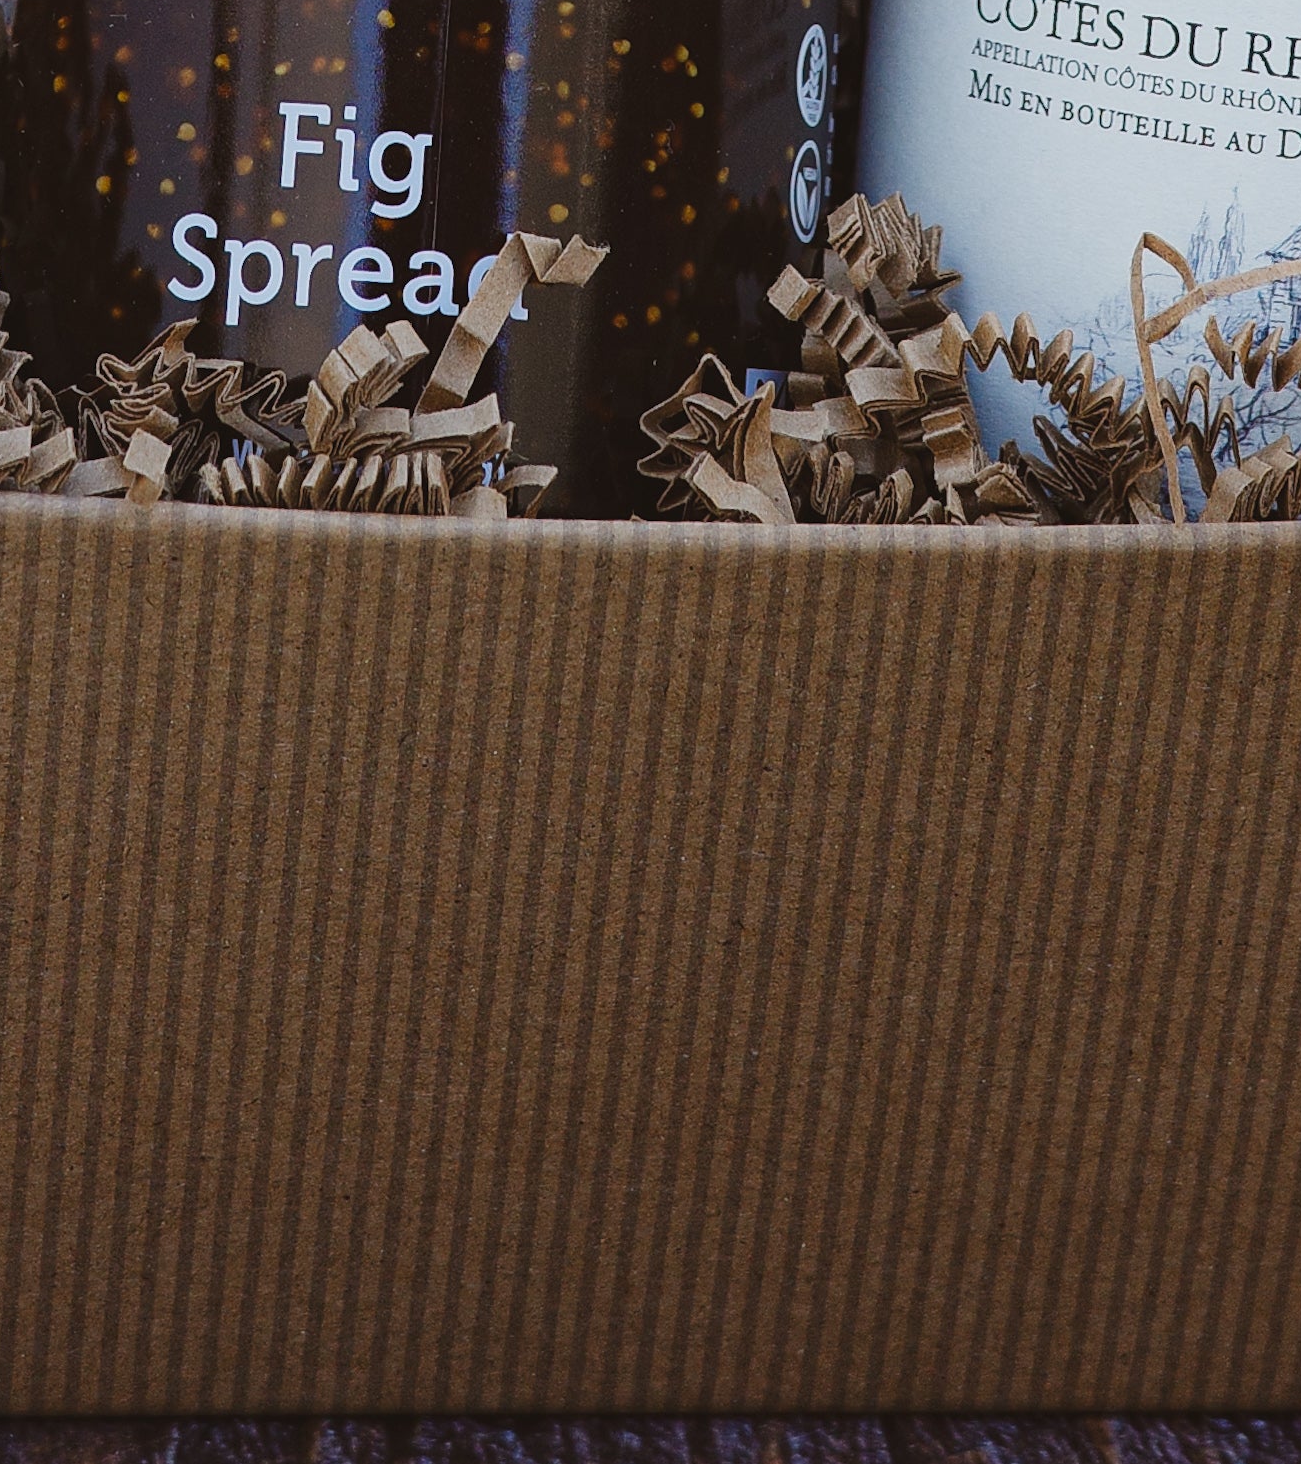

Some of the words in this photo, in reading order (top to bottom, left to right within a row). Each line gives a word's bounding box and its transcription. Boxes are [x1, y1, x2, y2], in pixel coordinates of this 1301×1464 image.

[970, 37, 1099, 84] APPELLATION
[1103, 63, 1174, 98] CÔTES
[1179, 82, 1217, 104] DU
[1138, 14, 1230, 71] DU
[1020, 91, 1053, 115] EN
[1060, 98, 1216, 150] BOUTEILLE
[1224, 132, 1267, 158] AU
[278, 101, 433, 220] Fig
